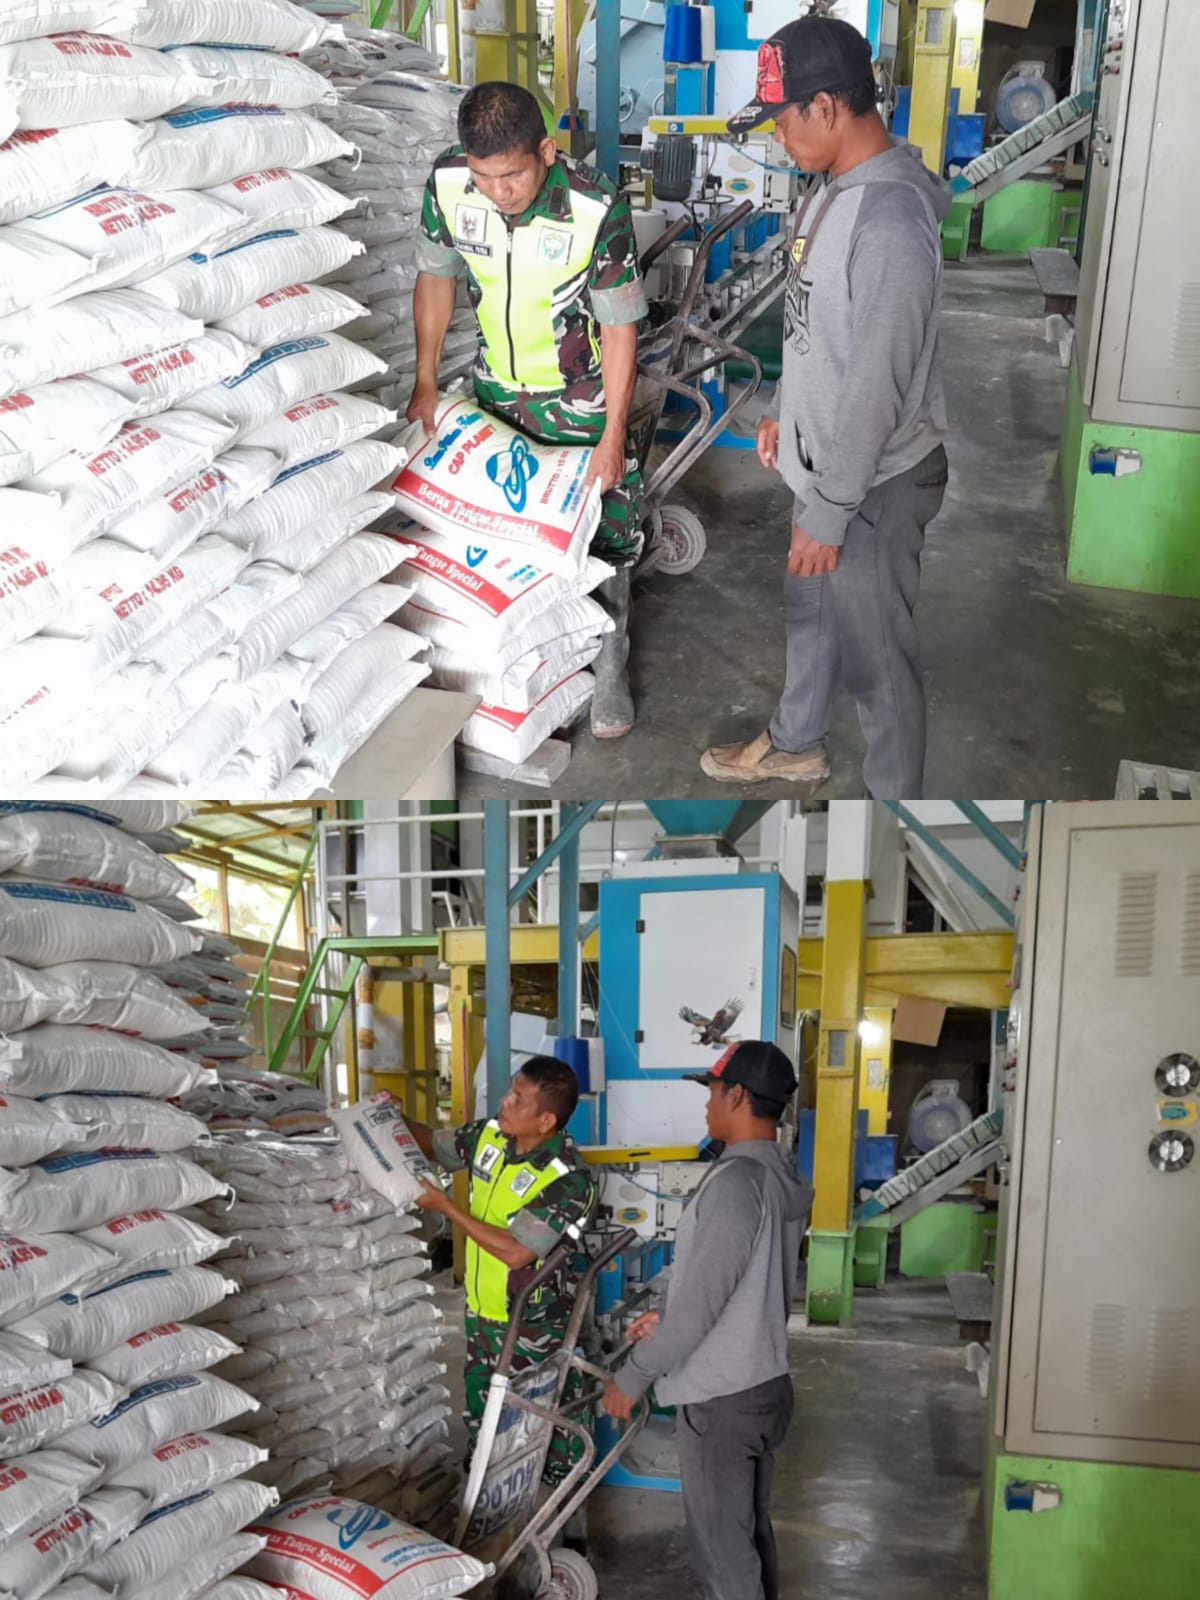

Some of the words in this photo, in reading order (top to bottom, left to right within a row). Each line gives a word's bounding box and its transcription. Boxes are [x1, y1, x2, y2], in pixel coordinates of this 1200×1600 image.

[98, 213, 133, 237] NETTO
[85, 449, 122, 476] NETTO
[448, 450, 465, 475] CAP
[461, 422, 497, 455] PLANET
[415, 546, 449, 571] Tangse
[446, 562, 485, 591] Special
[112, 591, 145, 620] NETTO
[316, 1547, 357, 1574] Special
